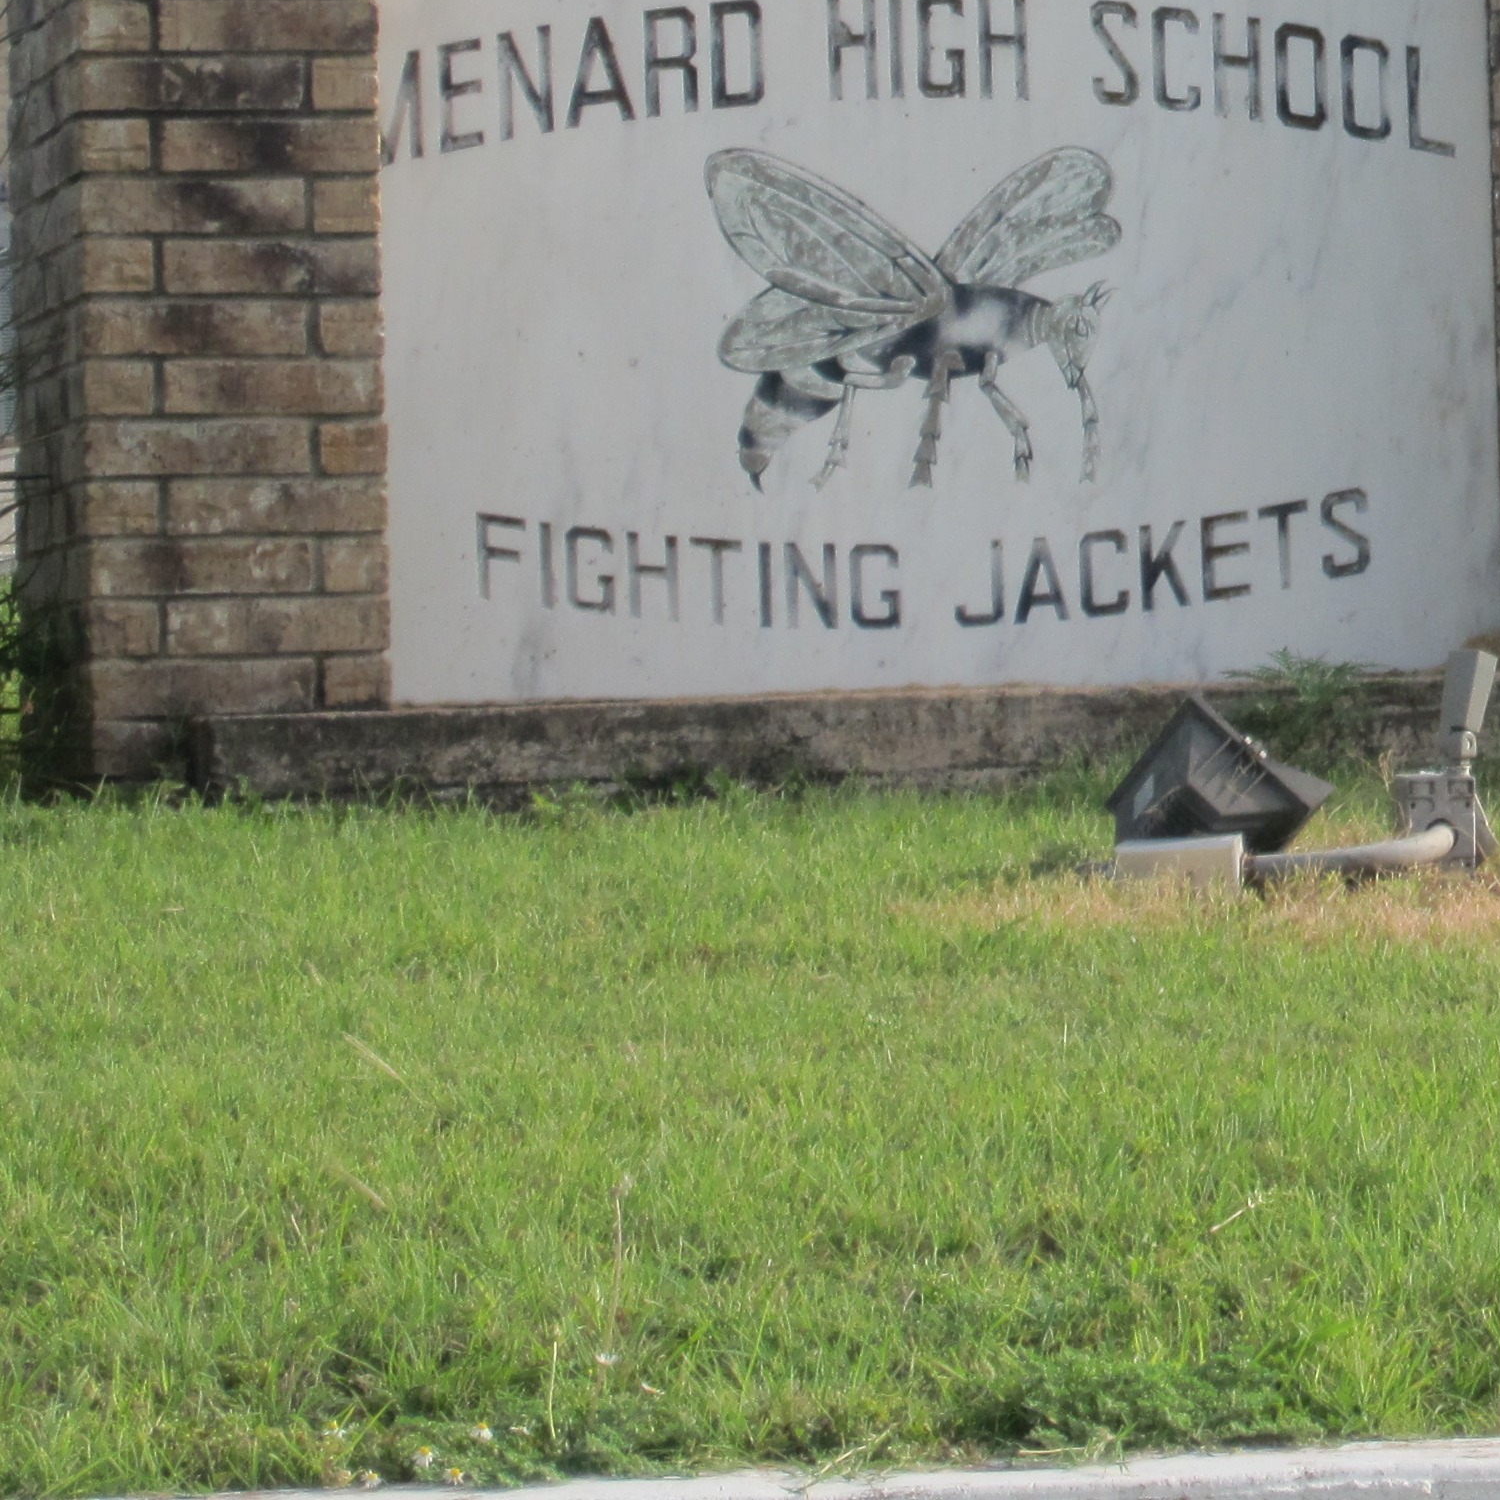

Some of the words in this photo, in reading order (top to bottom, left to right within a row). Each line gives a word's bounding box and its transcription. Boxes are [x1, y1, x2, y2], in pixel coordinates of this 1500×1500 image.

[1090, 0, 1456, 158] SCHOOL
[475, 511, 901, 630] FIGHTING
[954, 486, 1371, 629] JACKETS
